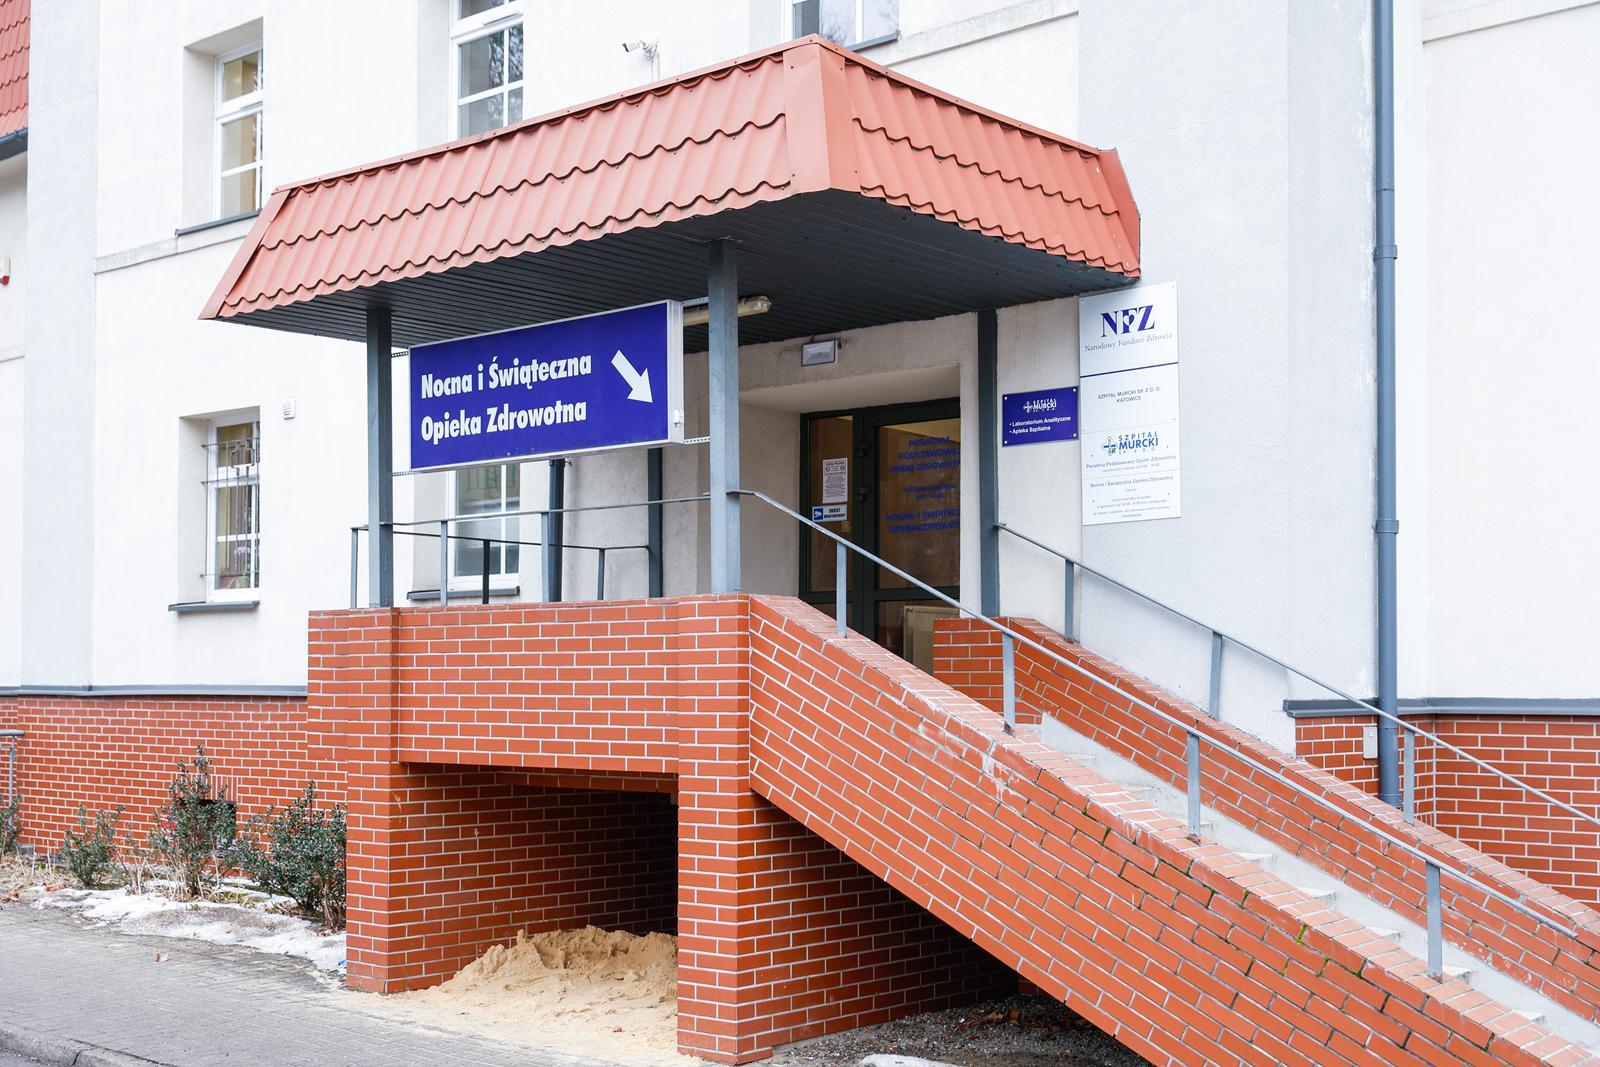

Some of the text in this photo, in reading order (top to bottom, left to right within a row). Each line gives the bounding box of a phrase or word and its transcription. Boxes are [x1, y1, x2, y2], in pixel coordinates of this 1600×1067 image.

[1101, 305, 1155, 337] NFZ
[1085, 332, 1173, 352] Narodowy Fundusz Zdrowia
[421, 355, 592, 399] Nocna i Świąteczna
[1033, 401, 1057, 410] MURCKI
[1117, 395, 1141, 403] KATOWICE
[421, 400, 587, 445] Opieka Zdrowotna
[1012, 419, 1043, 427] Laboratorium
[1118, 431, 1158, 442] SZPITAL
[1119, 437, 1158, 450] MURCKI
